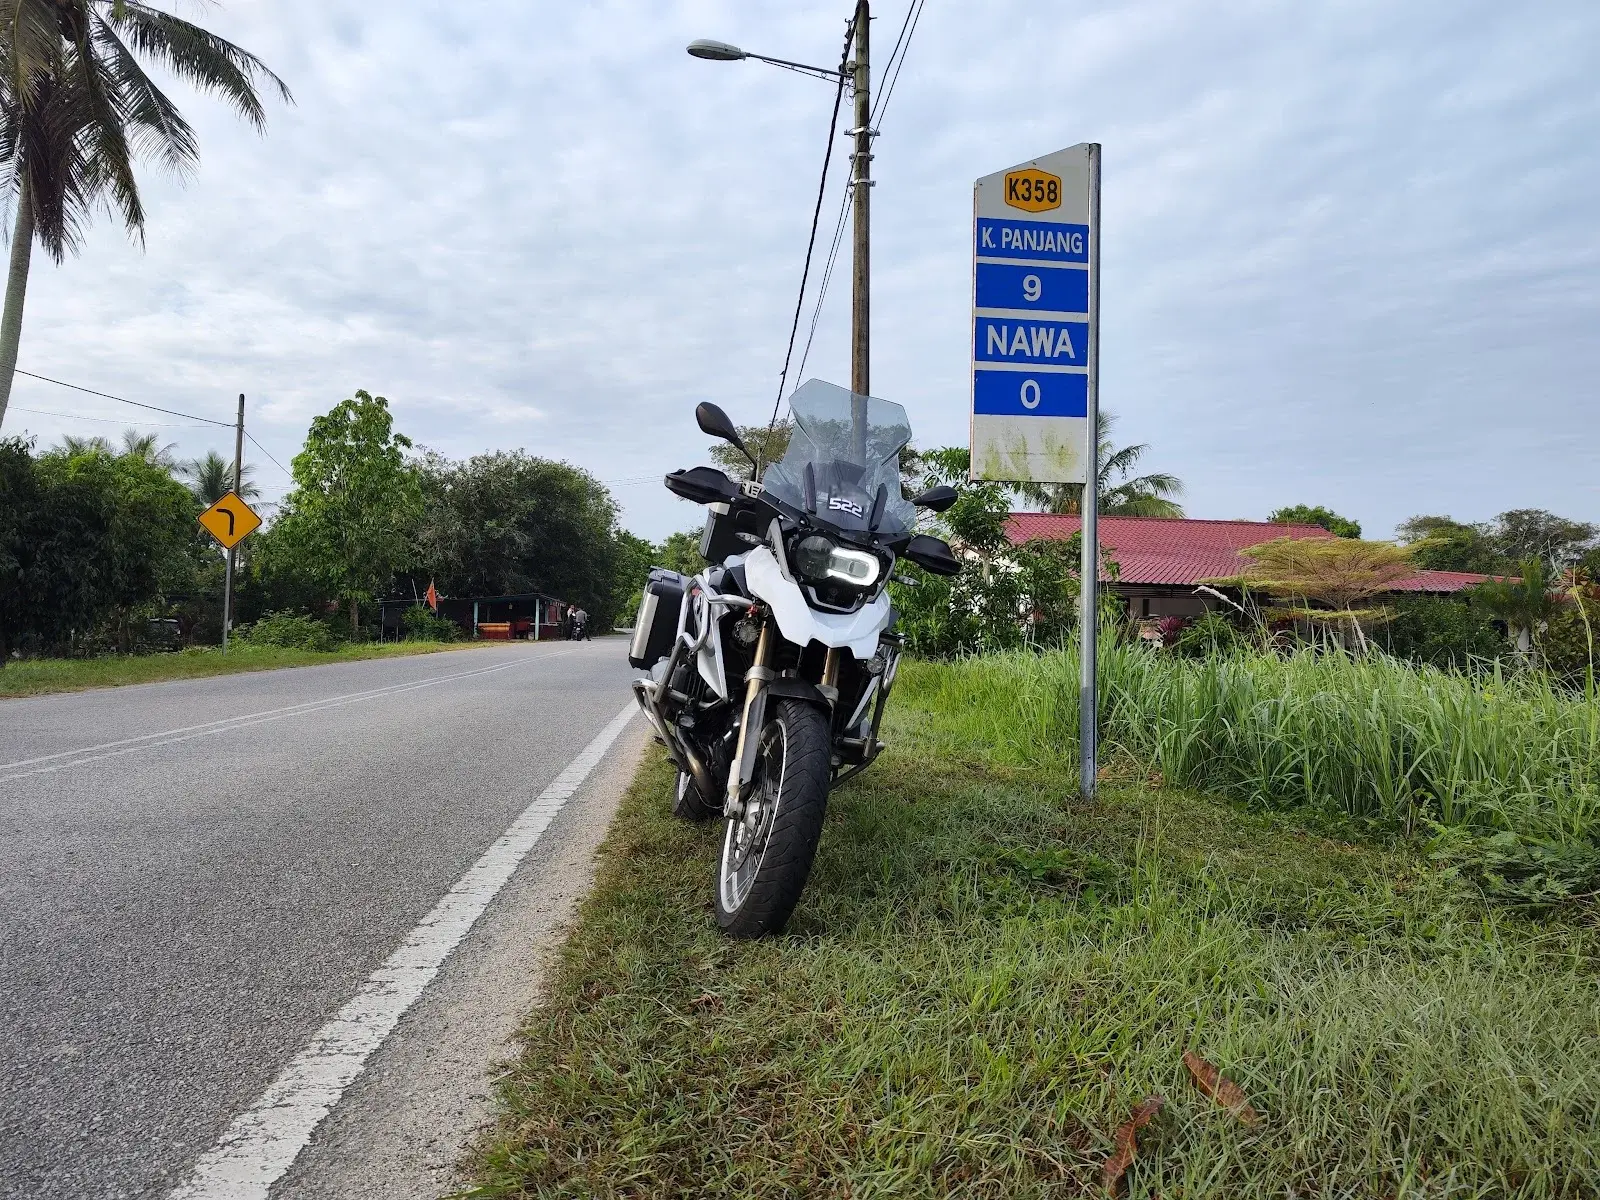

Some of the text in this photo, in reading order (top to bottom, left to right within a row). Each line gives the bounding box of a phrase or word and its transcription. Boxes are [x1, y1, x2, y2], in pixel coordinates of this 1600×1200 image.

[1009, 178, 1058, 203] K358
[981, 226, 1083, 254] K. PANJANG
[1022, 274, 1042, 302] 9
[987, 324, 1076, 359] NAWA
[1020, 379, 1041, 409] 0
[829, 498, 863, 518] 522
